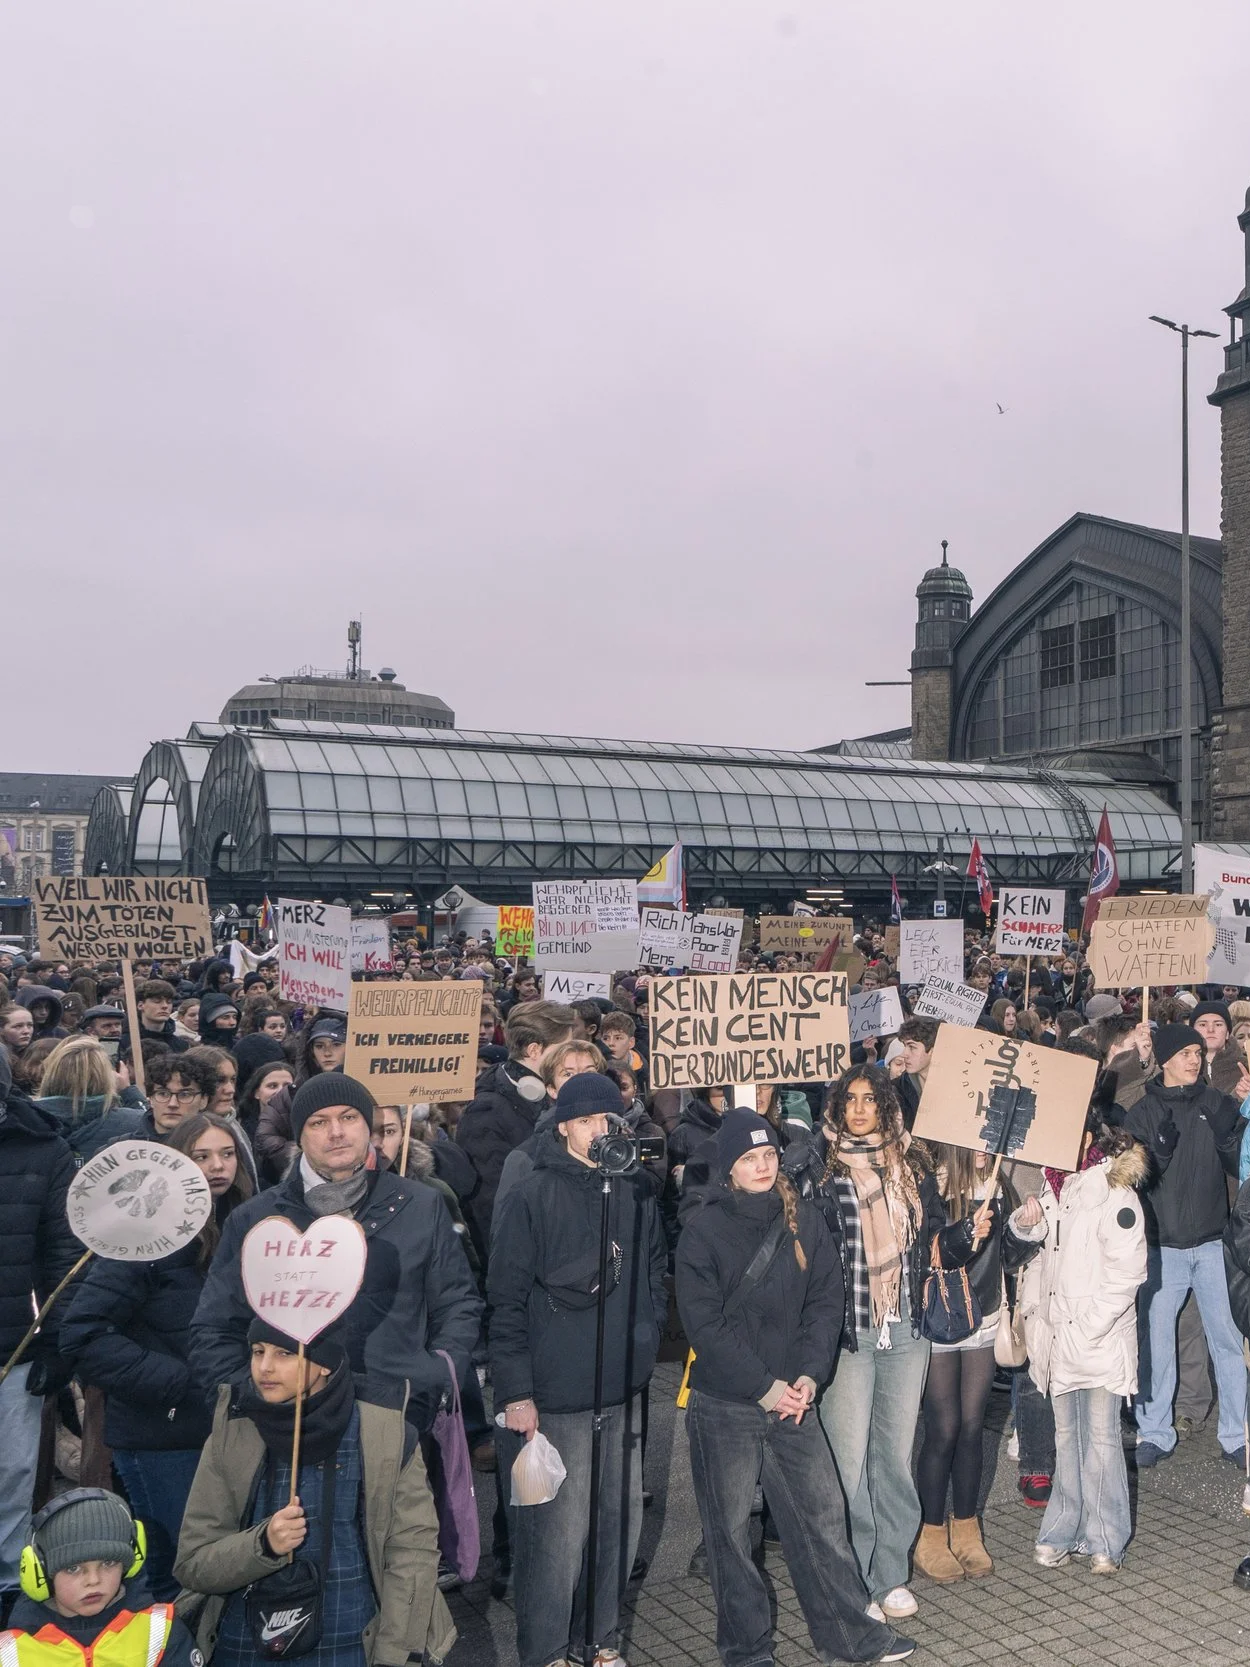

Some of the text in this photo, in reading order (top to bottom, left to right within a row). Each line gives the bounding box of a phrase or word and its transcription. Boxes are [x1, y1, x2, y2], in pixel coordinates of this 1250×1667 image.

[35, 878, 207, 905] WEIL WIR NICHT
[40, 903, 174, 925] ZUM TÖTEN
[1003, 892, 1051, 916] KEIN
[1106, 900, 1206, 918] FRIEDEN
[282, 904, 327, 927] MERZ
[645, 910, 678, 931] Rich
[766, 920, 853, 931] MEINE ZUKUNFT
[48, 923, 197, 942] AUSGEBILDET
[1001, 918, 1063, 935] SCHMERZ
[1106, 919, 1197, 939] SCHAFFEN
[57, 936, 206, 959] WERDEN WOLLEN
[691, 936, 719, 952] Poor
[765, 937, 849, 948] MEINE WAL
[1025, 936, 1061, 952] MERZ
[1118, 936, 1177, 953] OHNE
[285, 941, 306, 962] ICH
[312, 947, 344, 971] WILL
[640, 946, 675, 966] Mens
[1103, 952, 1197, 982] WAFFEN!
[282, 969, 344, 998] Menschen-
[928, 975, 955, 994] EQUAL
[355, 988, 482, 1017] WEHRPFLICHT?
[653, 975, 847, 1013] KEIN MENSCH
[387, 1033, 470, 1046] VERWEIGERE
[651, 1011, 820, 1050] KEIN CENT
[652, 1043, 847, 1088] DER BUNDESWEHR
[408, 1085, 464, 1100] #Hungergames
[83, 1148, 208, 1216] HIRN GEGEN HASS
[135, 1235, 176, 1256] HIRN
[263, 1239, 339, 1258] HERZ
[274, 1271, 319, 1282] STATT
[259, 1289, 342, 1309] HETZE
[267, 1607, 303, 1629] NIKE
